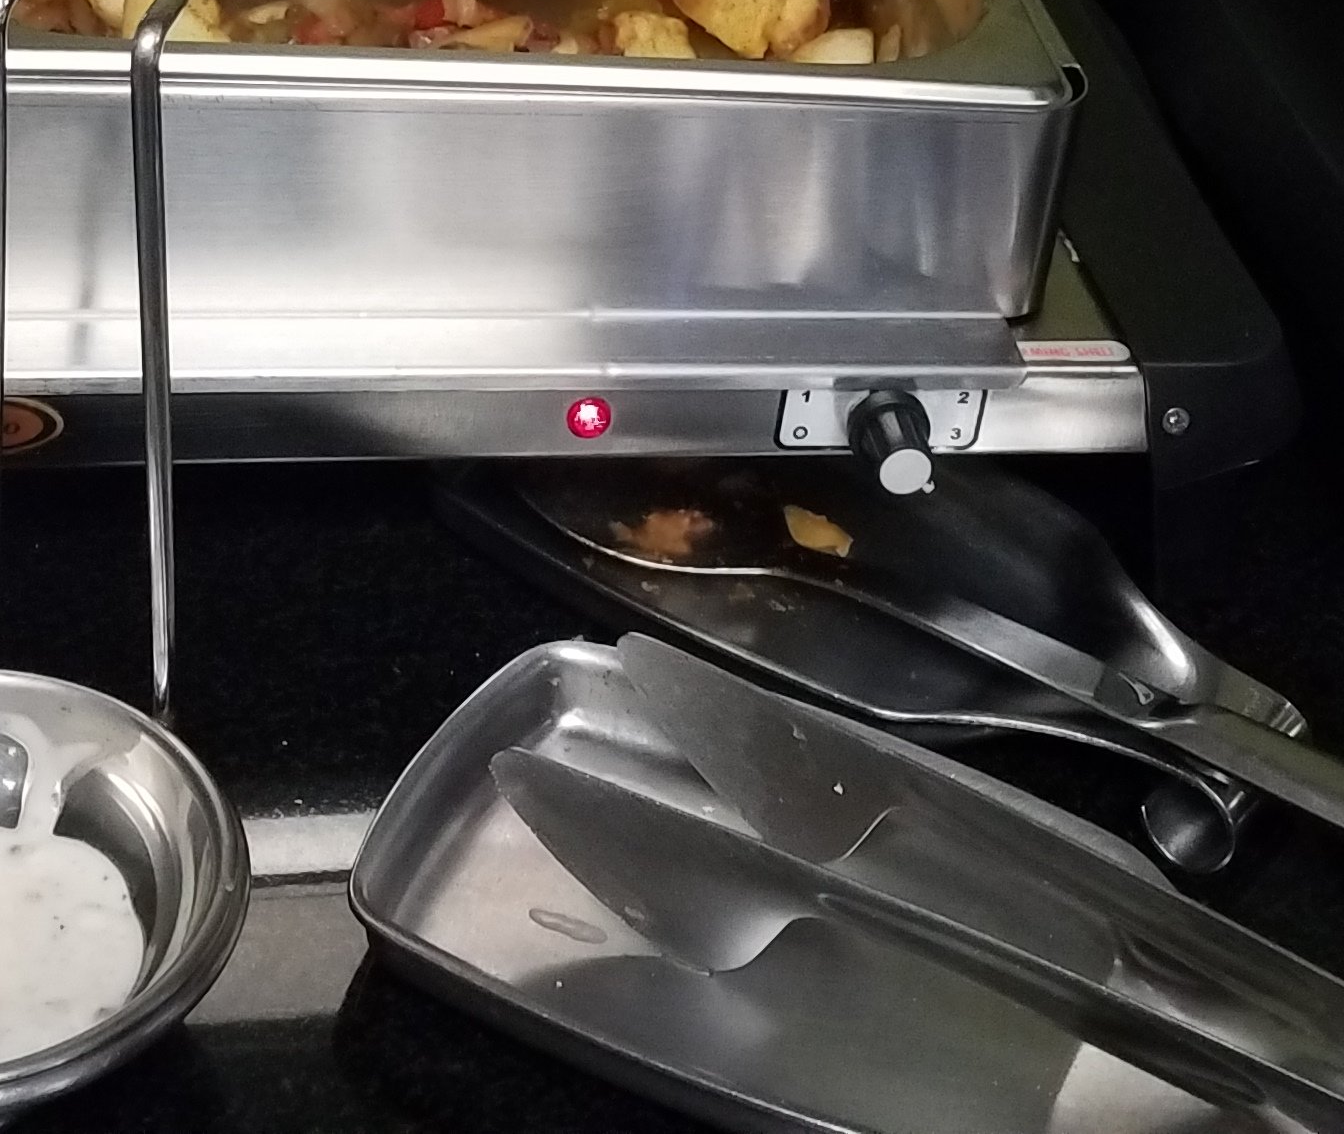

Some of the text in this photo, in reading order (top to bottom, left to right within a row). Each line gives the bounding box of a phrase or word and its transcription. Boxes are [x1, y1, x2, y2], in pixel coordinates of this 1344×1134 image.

[801, 390, 811, 403] 1
[957, 391, 970, 404] 2
[950, 427, 962, 441] 3
